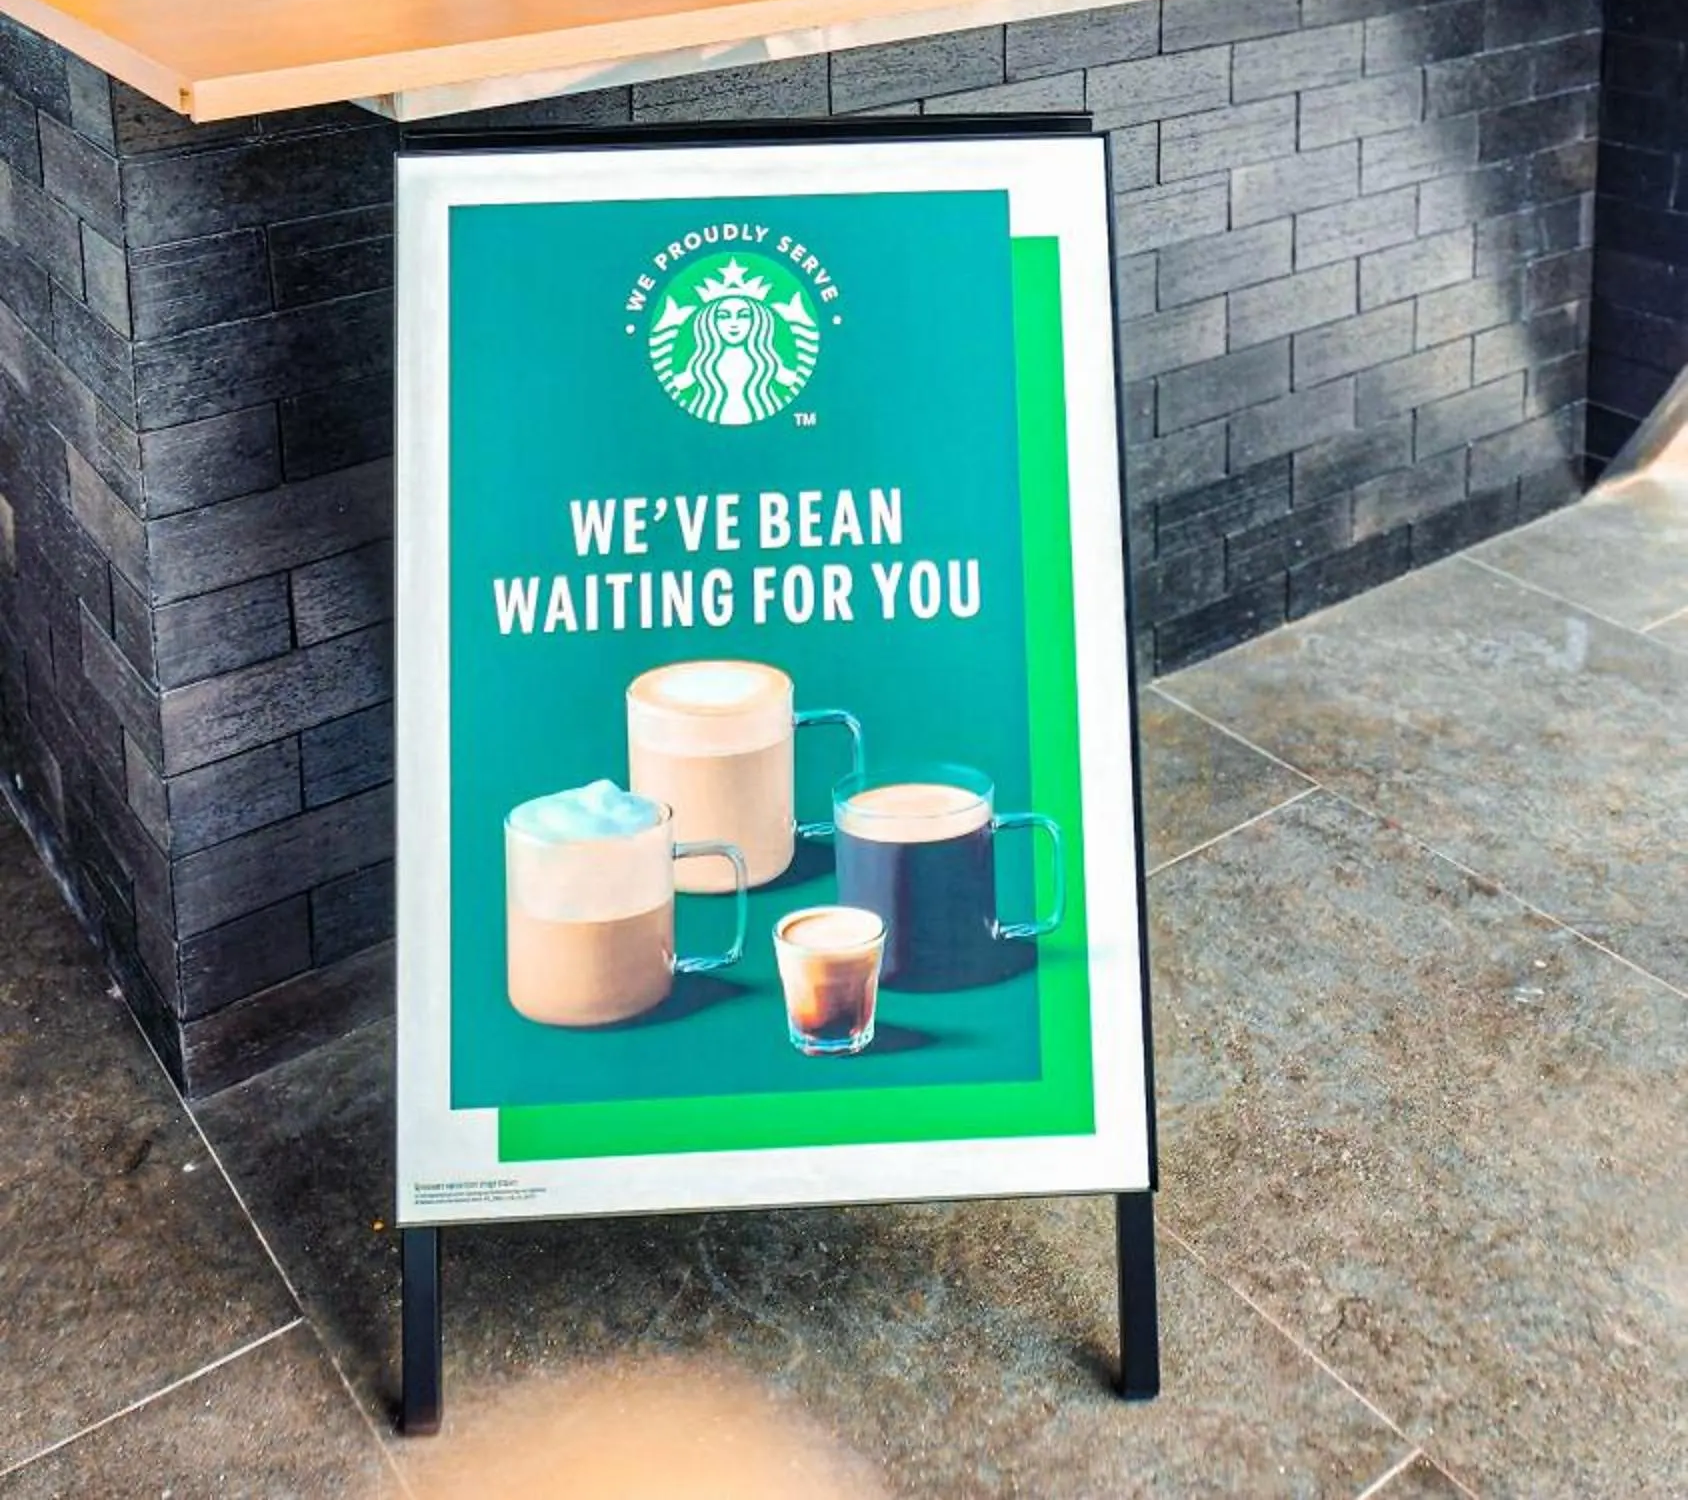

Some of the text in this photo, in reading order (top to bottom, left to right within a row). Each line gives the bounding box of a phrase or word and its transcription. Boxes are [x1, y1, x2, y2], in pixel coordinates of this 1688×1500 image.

[626, 223, 839, 311] WE PROUDLY SERVE
[793, 412, 816, 427] TM
[569, 487, 903, 556] WE'VE BEAN
[493, 558, 981, 635] WAITING FOR YOU
